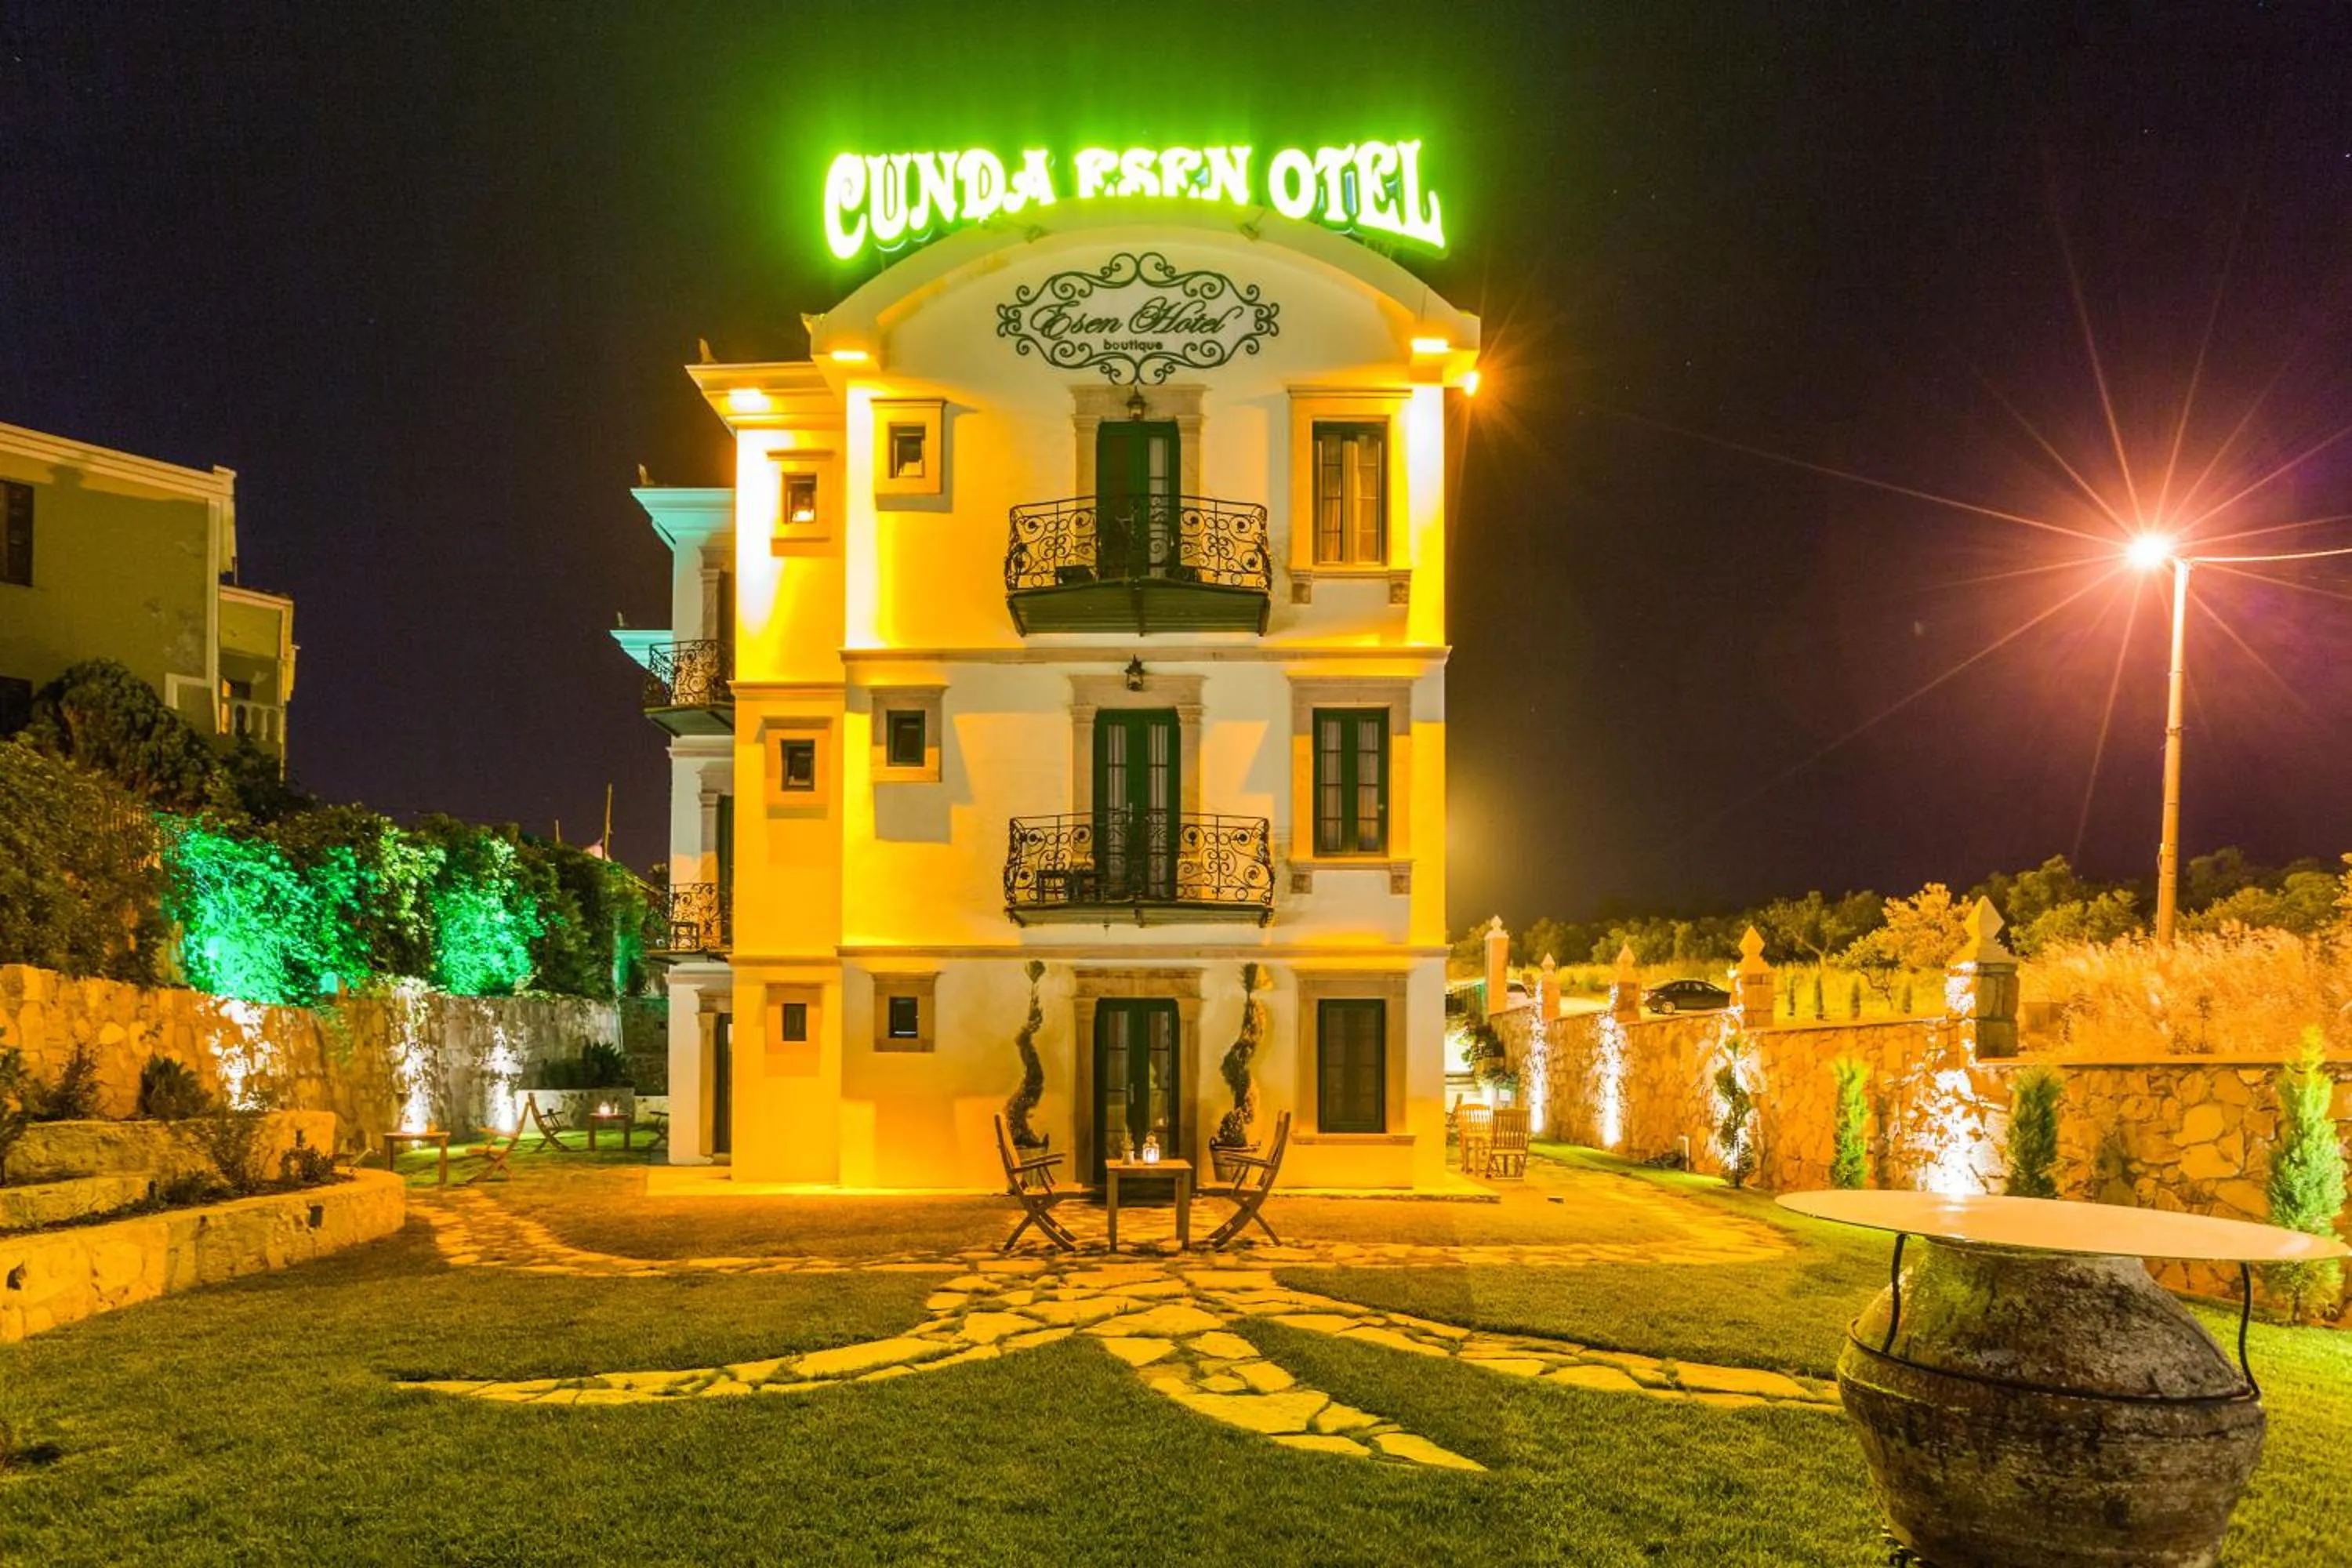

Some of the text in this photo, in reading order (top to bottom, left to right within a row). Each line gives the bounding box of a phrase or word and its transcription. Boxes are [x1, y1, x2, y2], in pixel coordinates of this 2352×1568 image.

[824, 148, 1057, 259] CUNDA
[1269, 140, 1445, 249] OTEL
[1029, 296, 1244, 340] Esen Hotel
[1103, 339, 1163, 351] boutique
